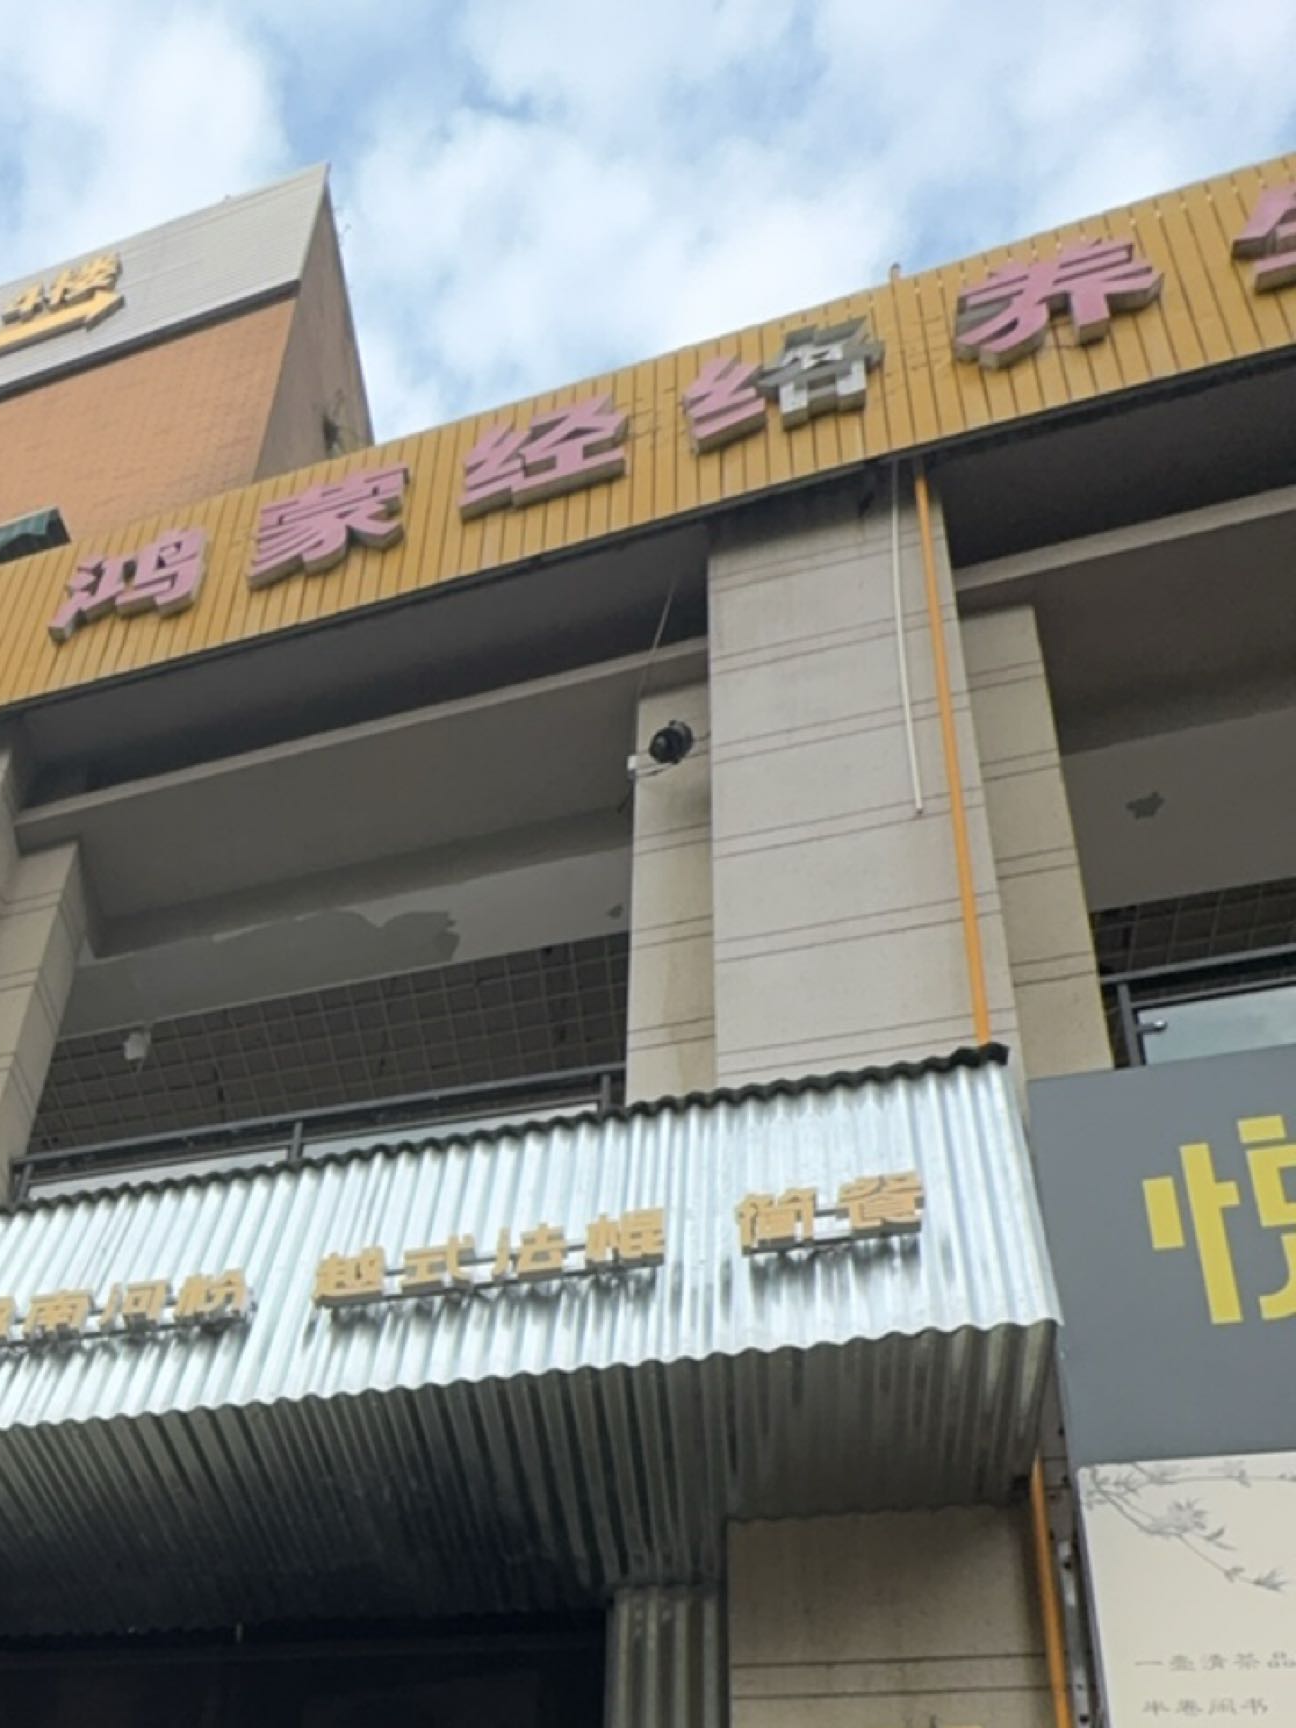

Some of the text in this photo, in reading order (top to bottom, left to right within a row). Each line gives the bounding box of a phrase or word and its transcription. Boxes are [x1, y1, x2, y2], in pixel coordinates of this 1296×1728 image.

[316, 1207, 664, 1304] 越式法棍
[735, 1172, 922, 1252] 简餐
